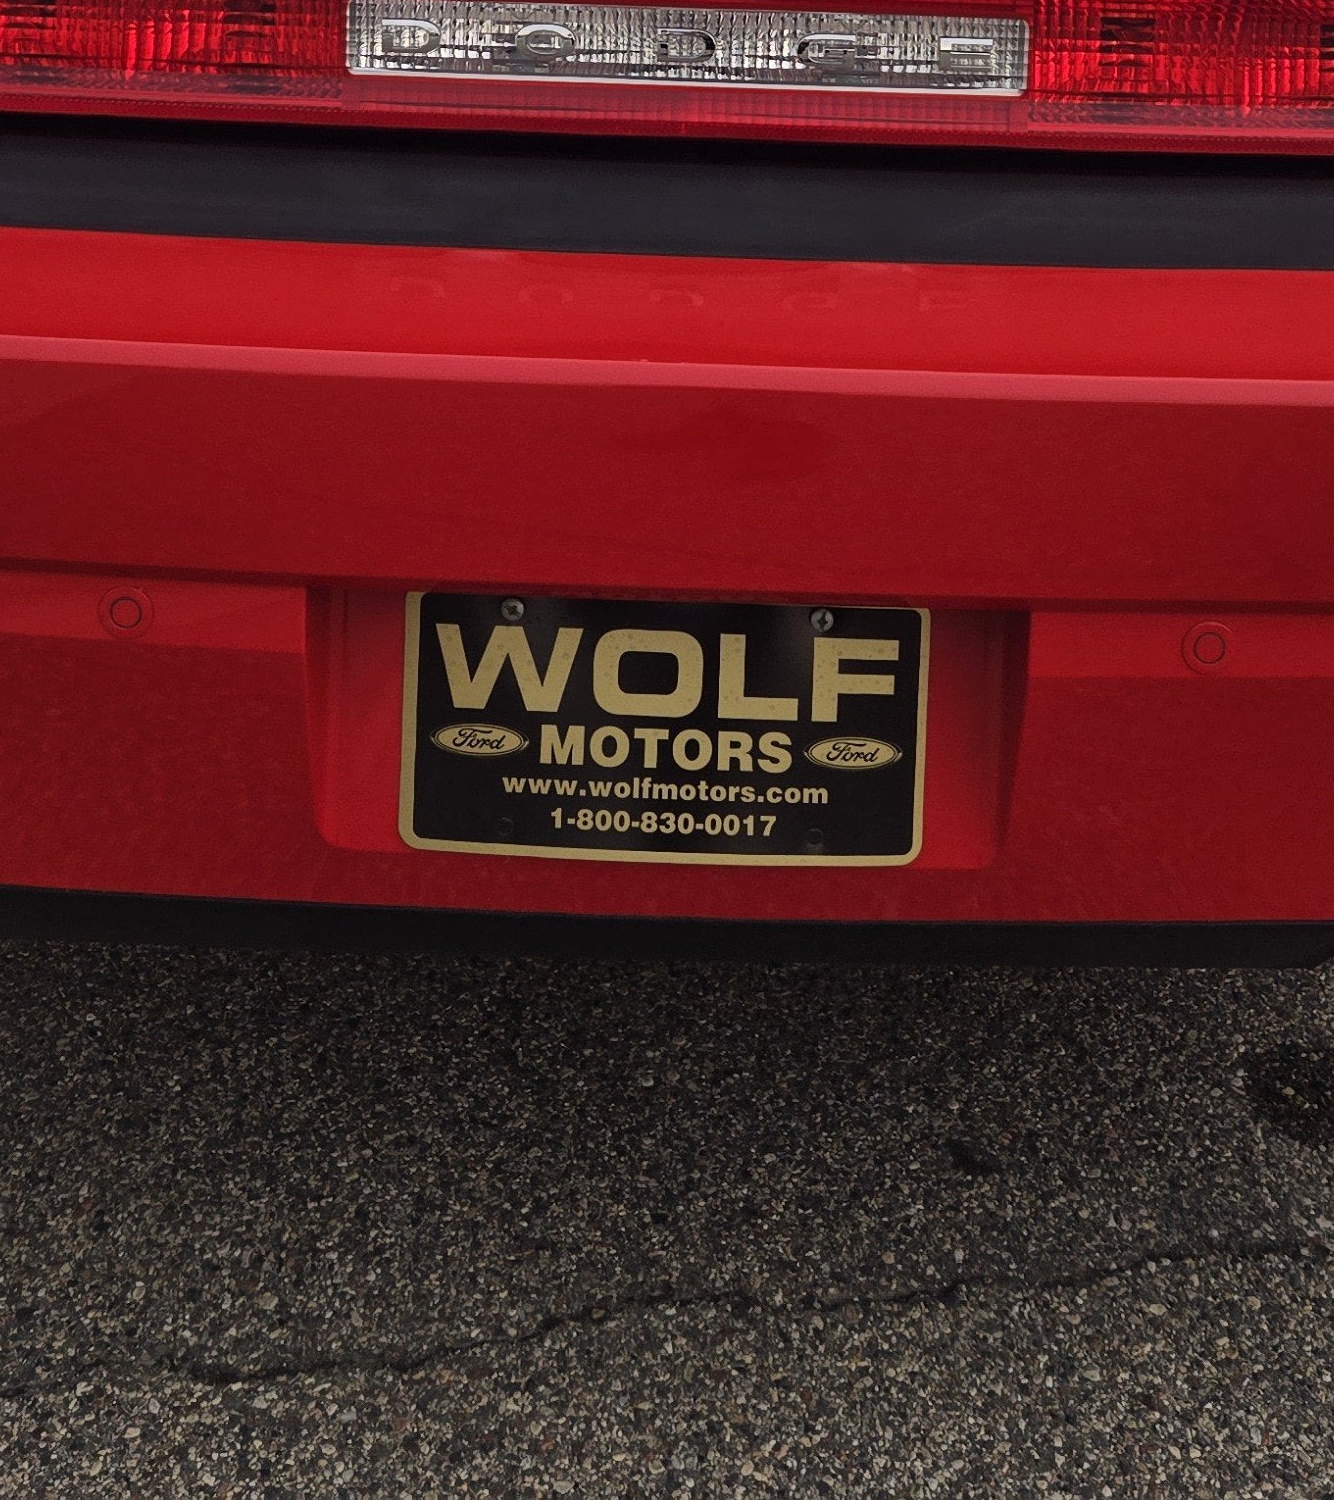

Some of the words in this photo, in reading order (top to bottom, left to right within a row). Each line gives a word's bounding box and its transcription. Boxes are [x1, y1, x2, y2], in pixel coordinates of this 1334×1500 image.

[380, 17, 995, 71] DODGE
[435, 622, 901, 723] WOLF
[452, 728, 506, 750] Ford
[539, 723, 794, 774] MOTORS
[826, 741, 881, 763] Ford
[501, 773, 830, 805] www.wolfmotors.com
[549, 807, 778, 838] 1-800-830-0017
